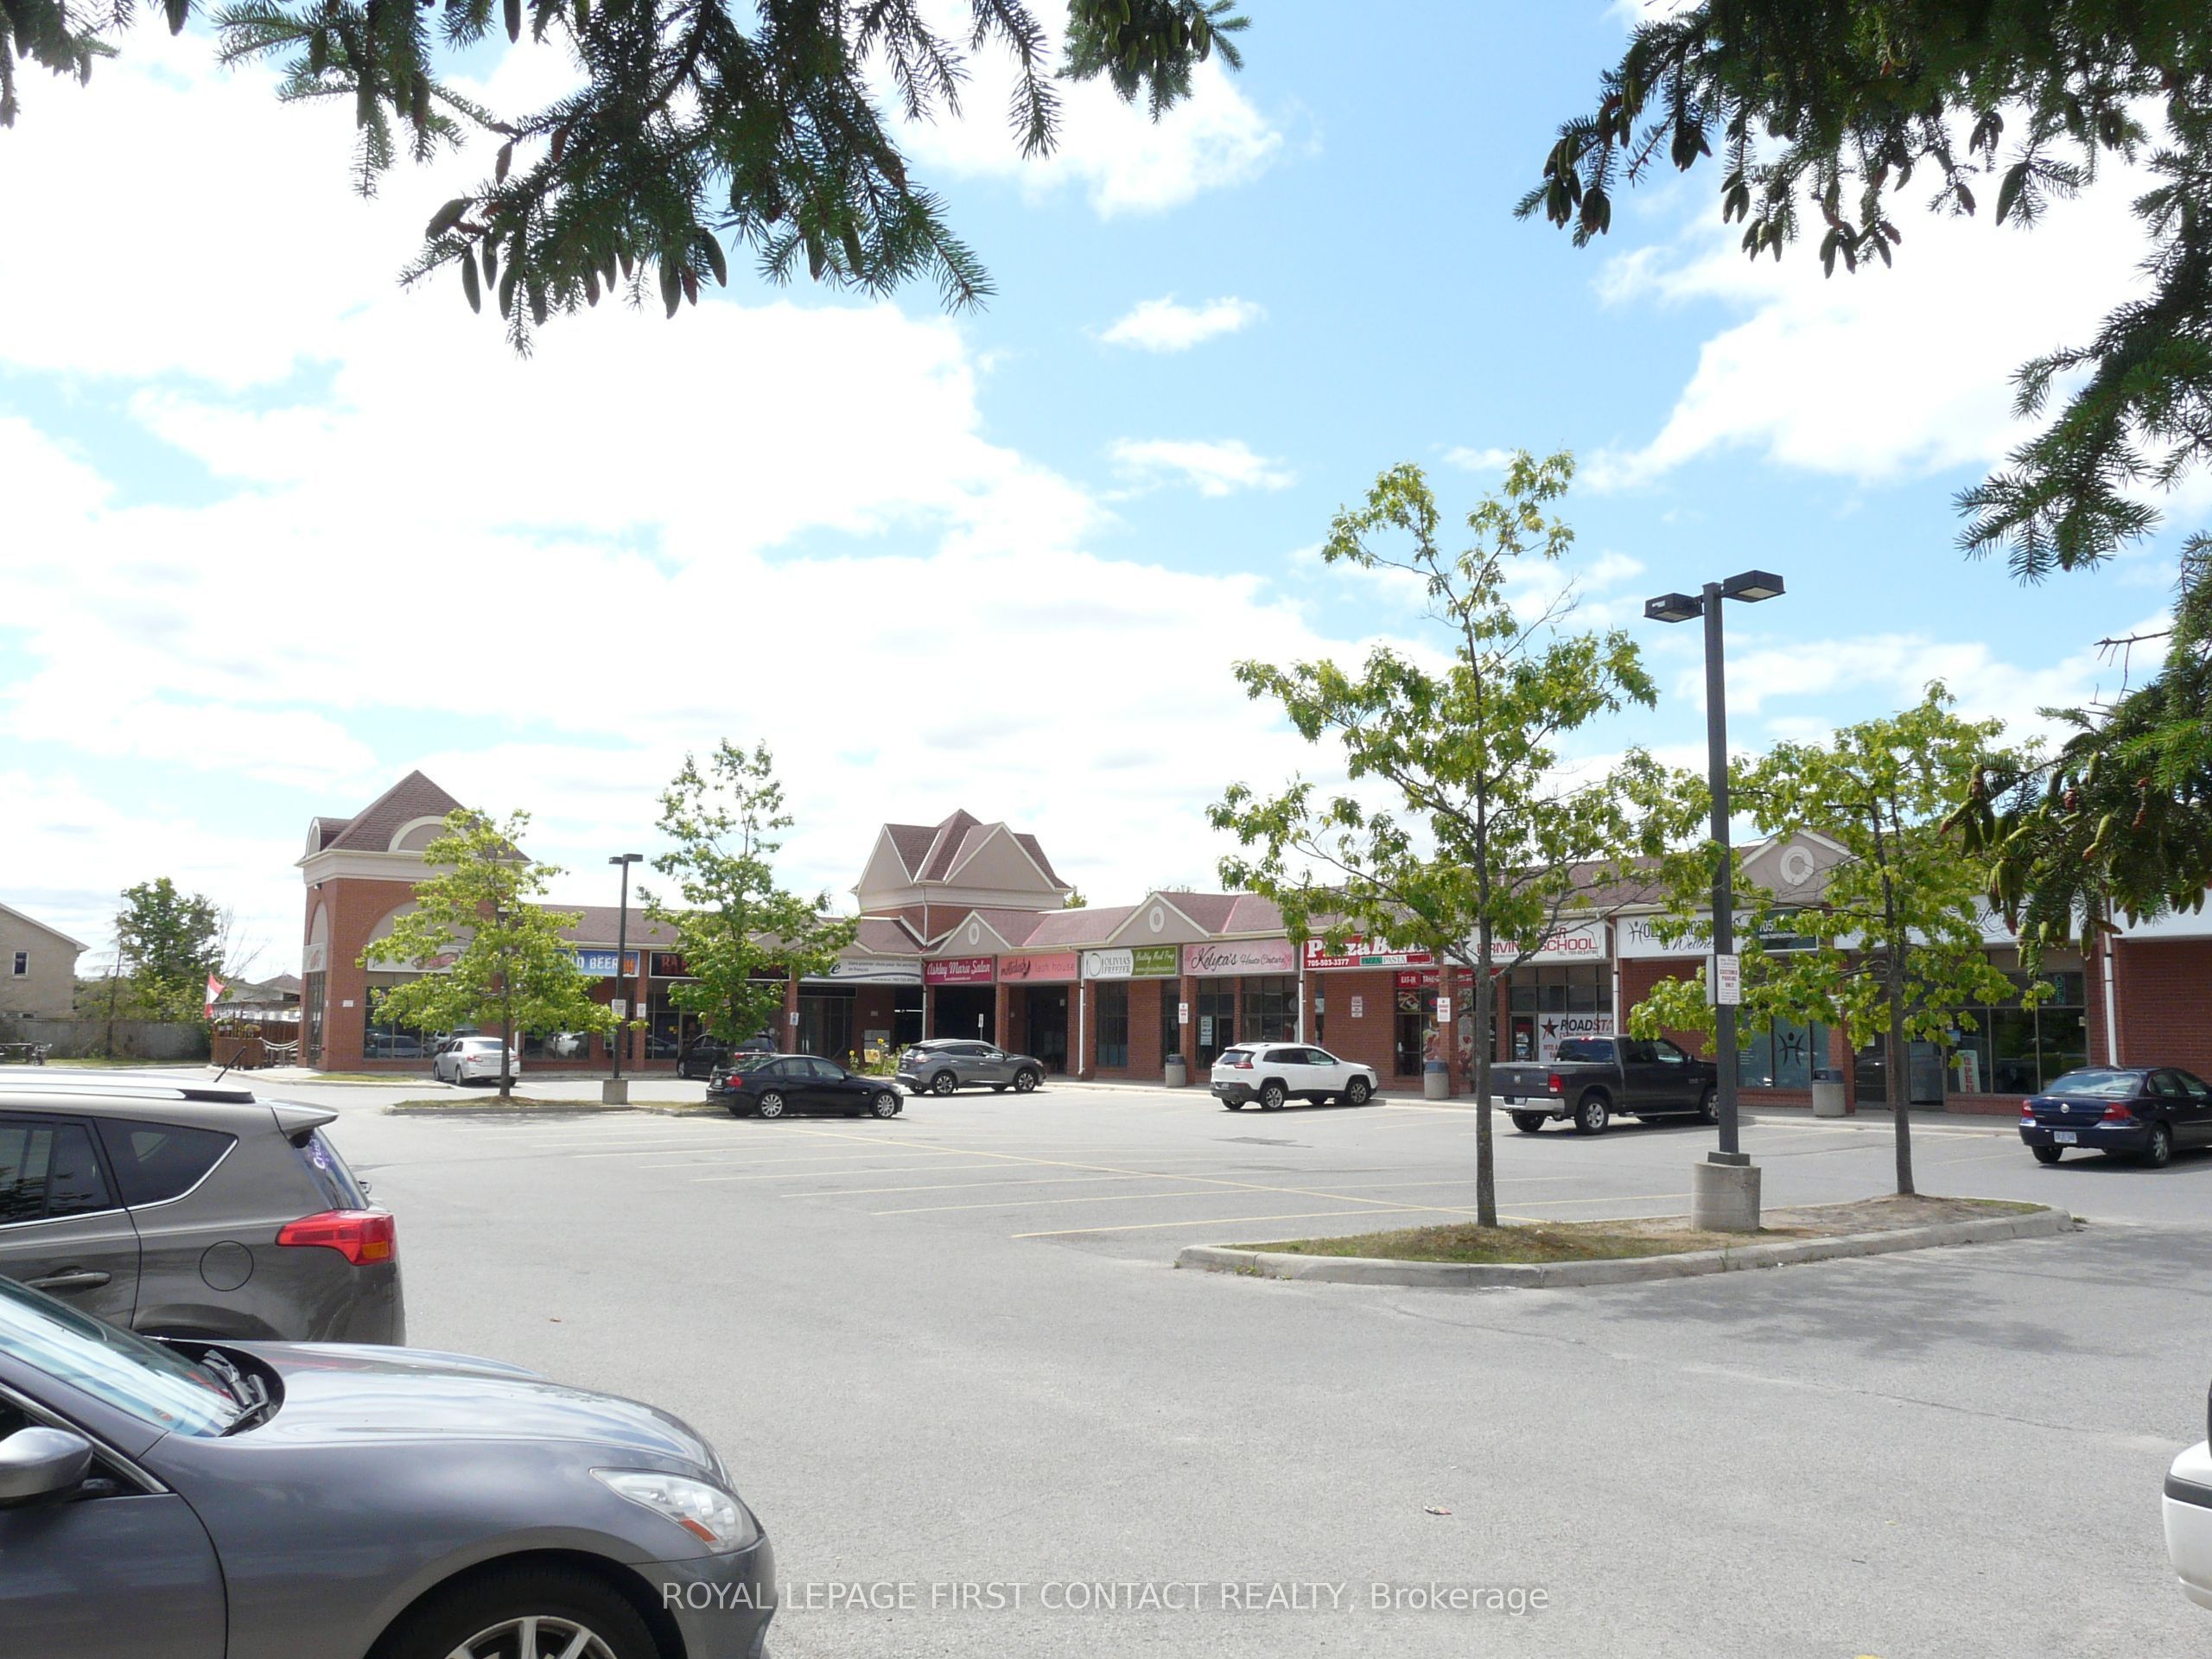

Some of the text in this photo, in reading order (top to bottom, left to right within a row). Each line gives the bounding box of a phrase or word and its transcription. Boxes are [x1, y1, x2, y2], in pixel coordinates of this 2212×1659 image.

[1673, 937, 1714, 951] Wellne
[589, 955, 619, 969] BEER
[1052, 961, 1075, 972] house
[1104, 956, 1130, 966] OLIVIA'S
[927, 962, 947, 977] Ashley
[949, 961, 970, 974] Marie
[971, 960, 990, 975] Salon
[1560, 1020, 1614, 1032] ROADSTA
